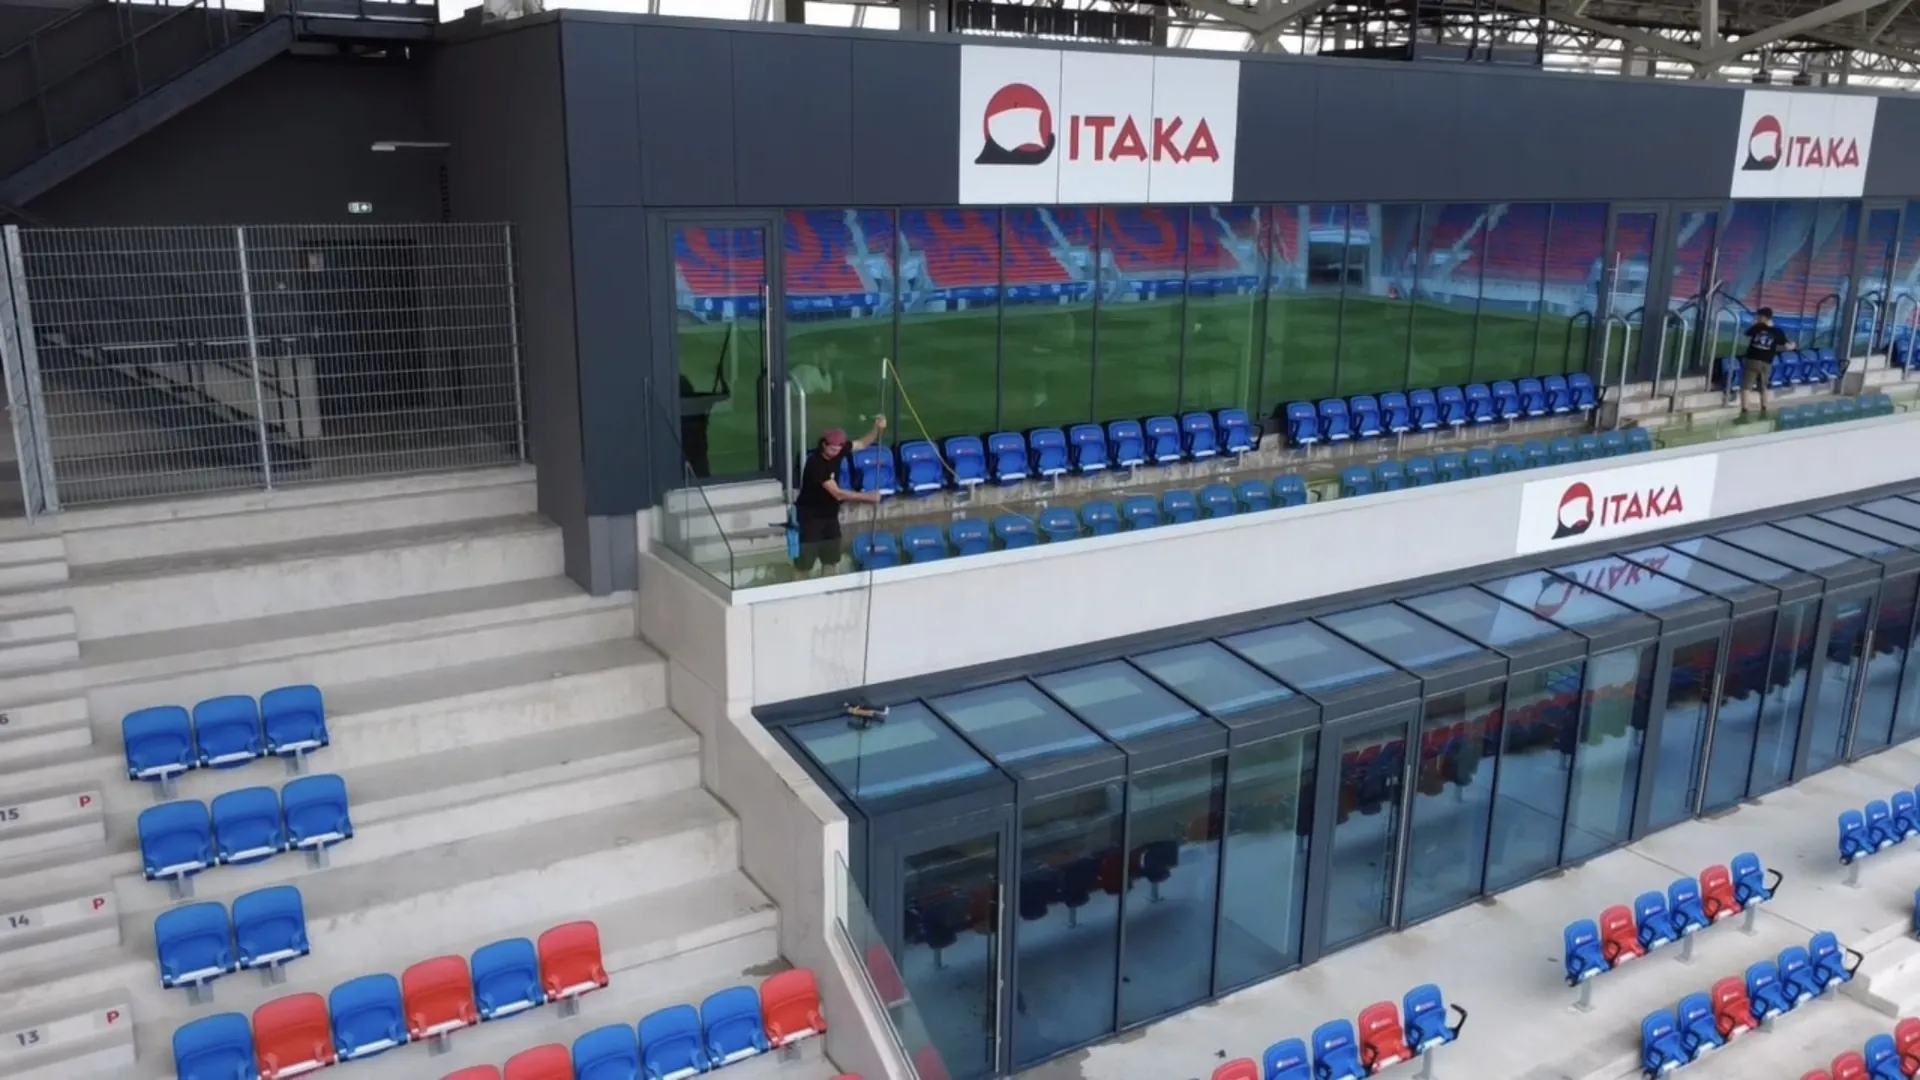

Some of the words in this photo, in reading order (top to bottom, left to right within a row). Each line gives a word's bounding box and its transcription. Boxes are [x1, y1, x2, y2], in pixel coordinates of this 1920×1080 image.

[1069, 114, 1220, 164] ITAKA
[1785, 136, 1860, 168] ITAKA
[1600, 484, 1683, 527] ITAKA
[79, 795, 91, 808] P
[0, 807, 20, 822] 15
[92, 897, 105, 910] P
[8, 914, 30, 929] 14
[106, 1010, 120, 1024] P
[16, 1030, 40, 1047] 13
